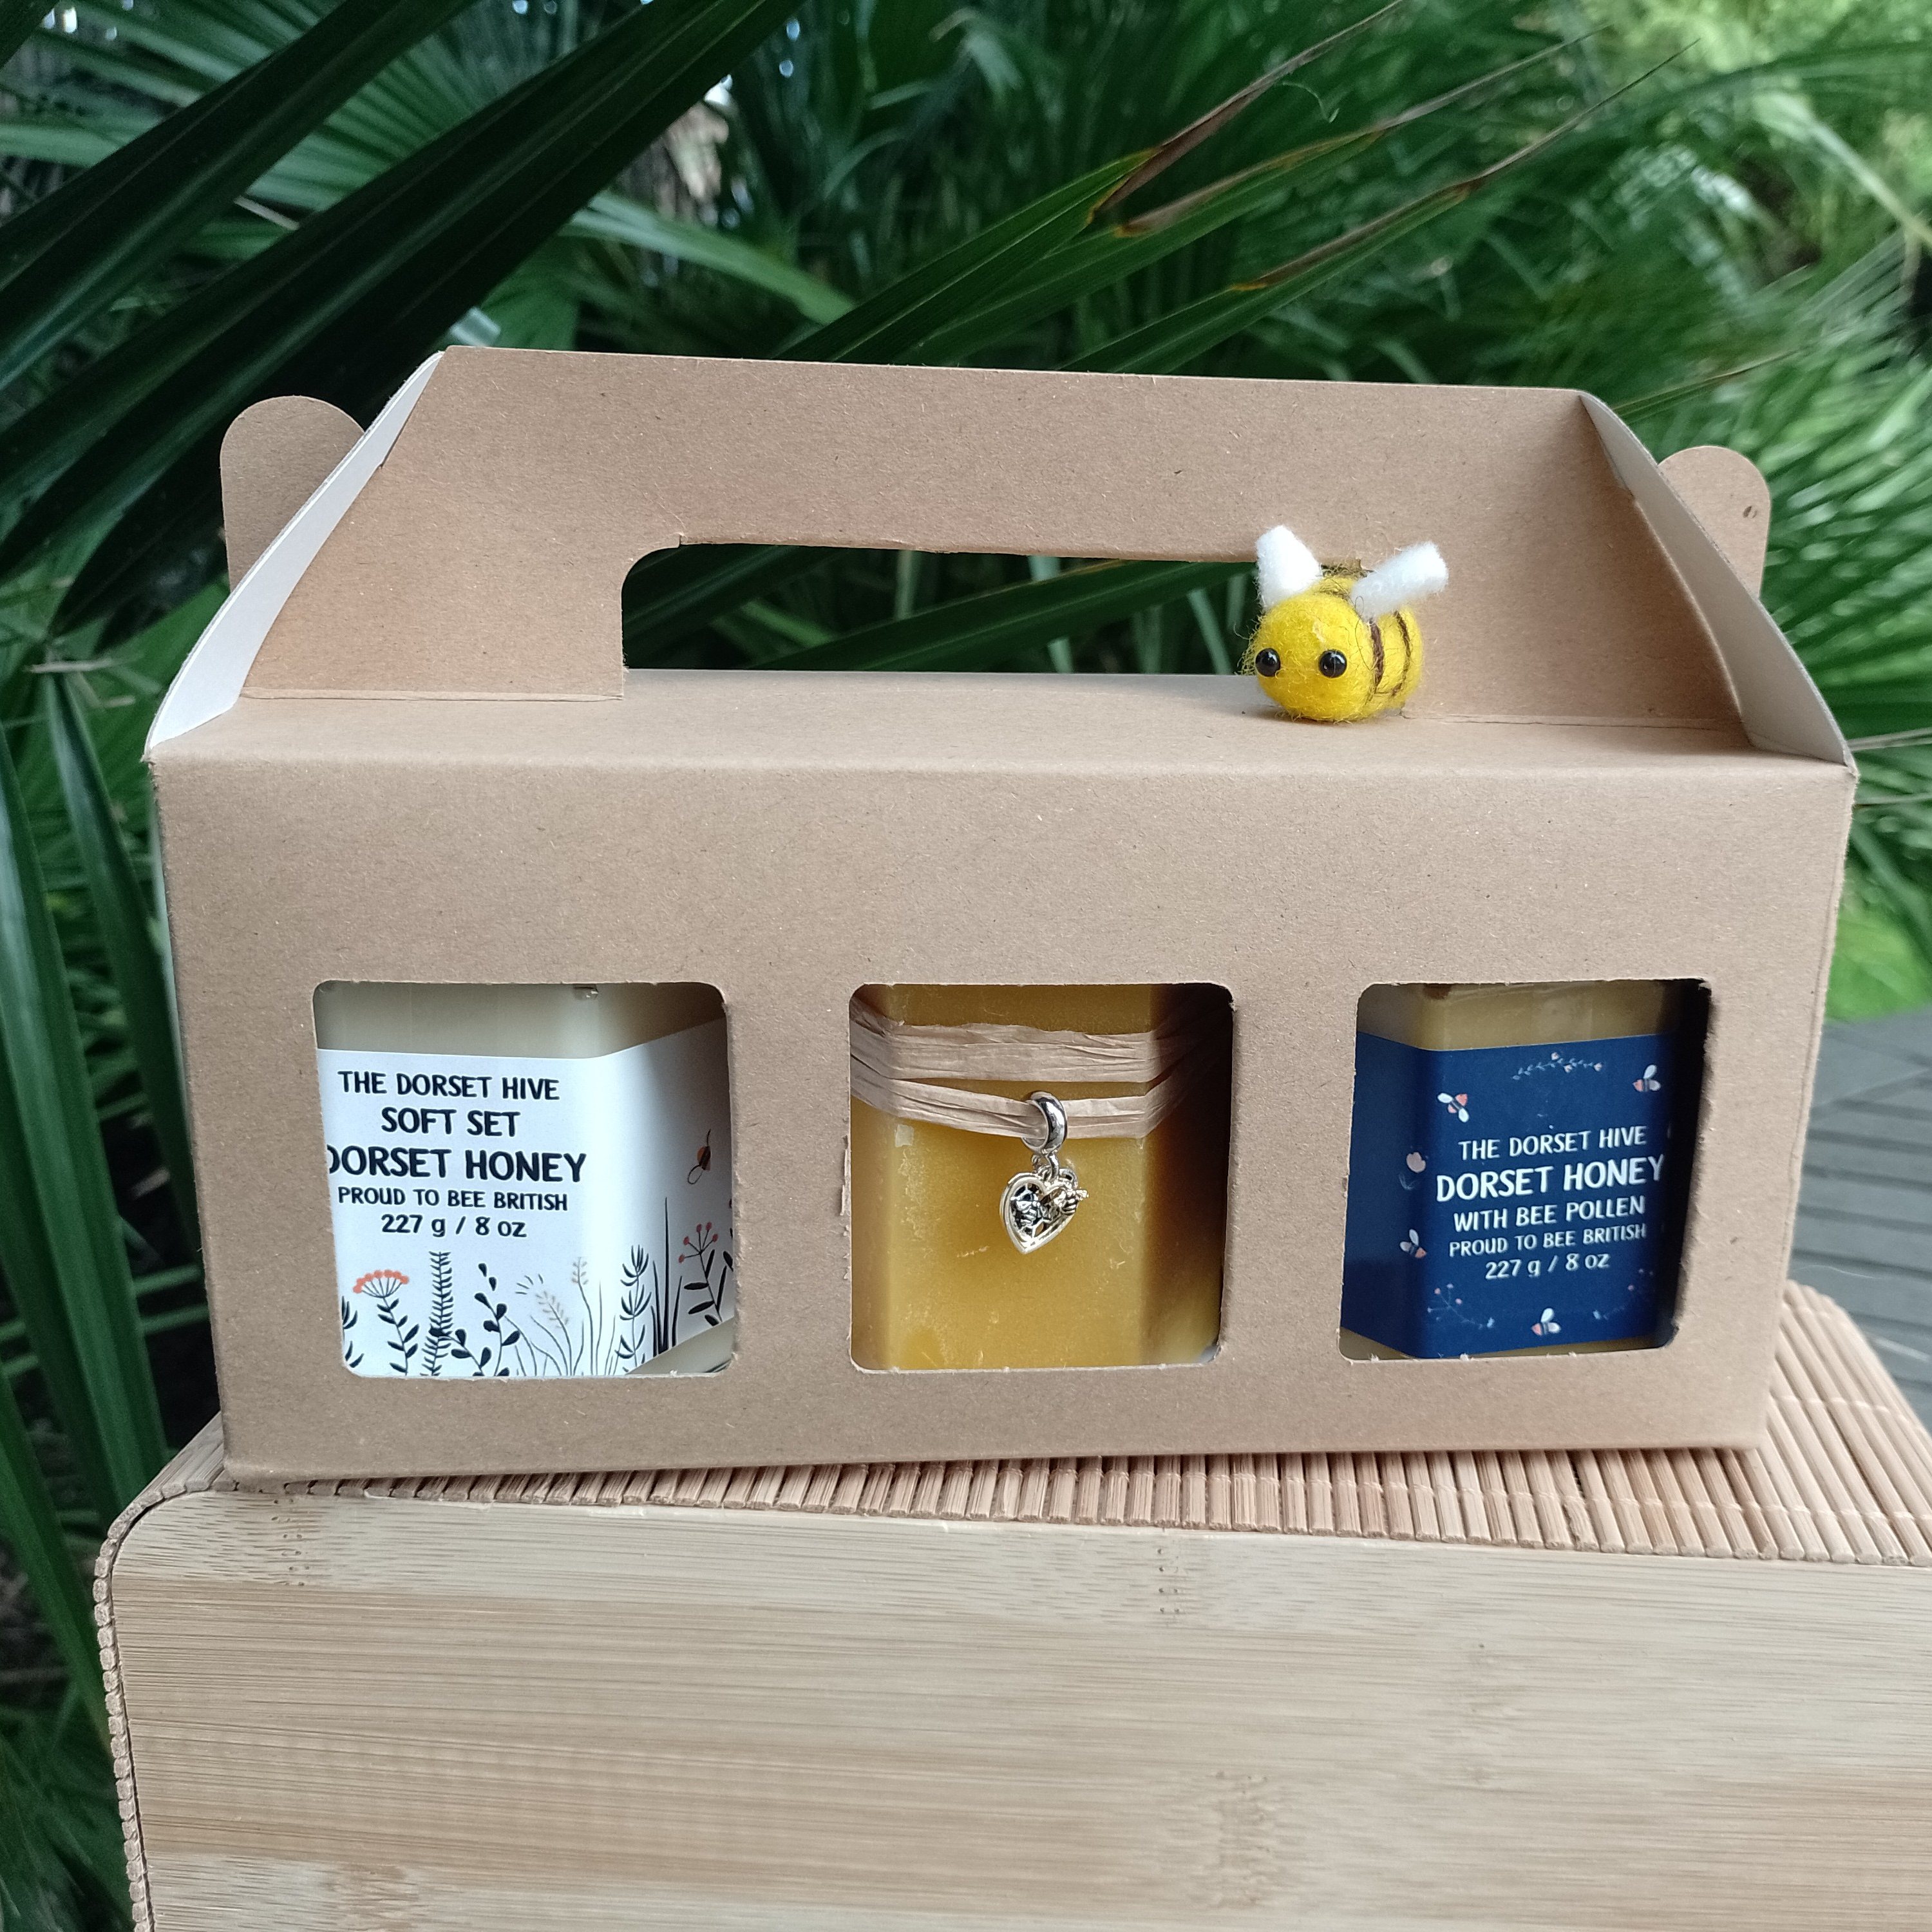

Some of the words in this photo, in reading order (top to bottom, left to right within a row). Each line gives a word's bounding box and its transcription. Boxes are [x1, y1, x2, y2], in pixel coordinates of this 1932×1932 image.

[337, 1070, 387, 1094] THE
[396, 1073, 493, 1098] DORSET
[502, 1077, 560, 1101] HIVE
[381, 1106, 457, 1135] SOFT
[466, 1110, 521, 1137] SET
[1458, 1139, 1501, 1160] THE
[1509, 1130, 1591, 1157] DORSET
[1598, 1126, 1645, 1149] HIVE
[465, 1150, 587, 1183] HONEY
[1436, 1166, 1553, 1202] DORSET
[1563, 1154, 1665, 1191] HONEY
[337, 1186, 406, 1206] PROUD
[414, 1189, 440, 1206] TO
[447, 1189, 486, 1208] BEE
[493, 1191, 568, 1211] BRITISH
[1454, 1208, 1508, 1232] WITH
[1515, 1204, 1557, 1227] BEE
[1566, 1195, 1644, 1222] POLLEN
[381, 1213, 423, 1234] 227
[431, 1218, 446, 1238] g
[455, 1216, 466, 1235] /
[475, 1216, 491, 1236] 8
[497, 1220, 527, 1238] oz
[1449, 1237, 1508, 1257] PROUD
[1514, 1234, 1537, 1251] TO
[1542, 1231, 1575, 1248] BEE
[1582, 1224, 1645, 1245] BRITISH
[1485, 1259, 1522, 1280] 227
[1527, 1260, 1540, 1277] g
[1548, 1255, 1558, 1273] /
[1565, 1253, 1579, 1271] 8
[1584, 1253, 1610, 1269] oz
